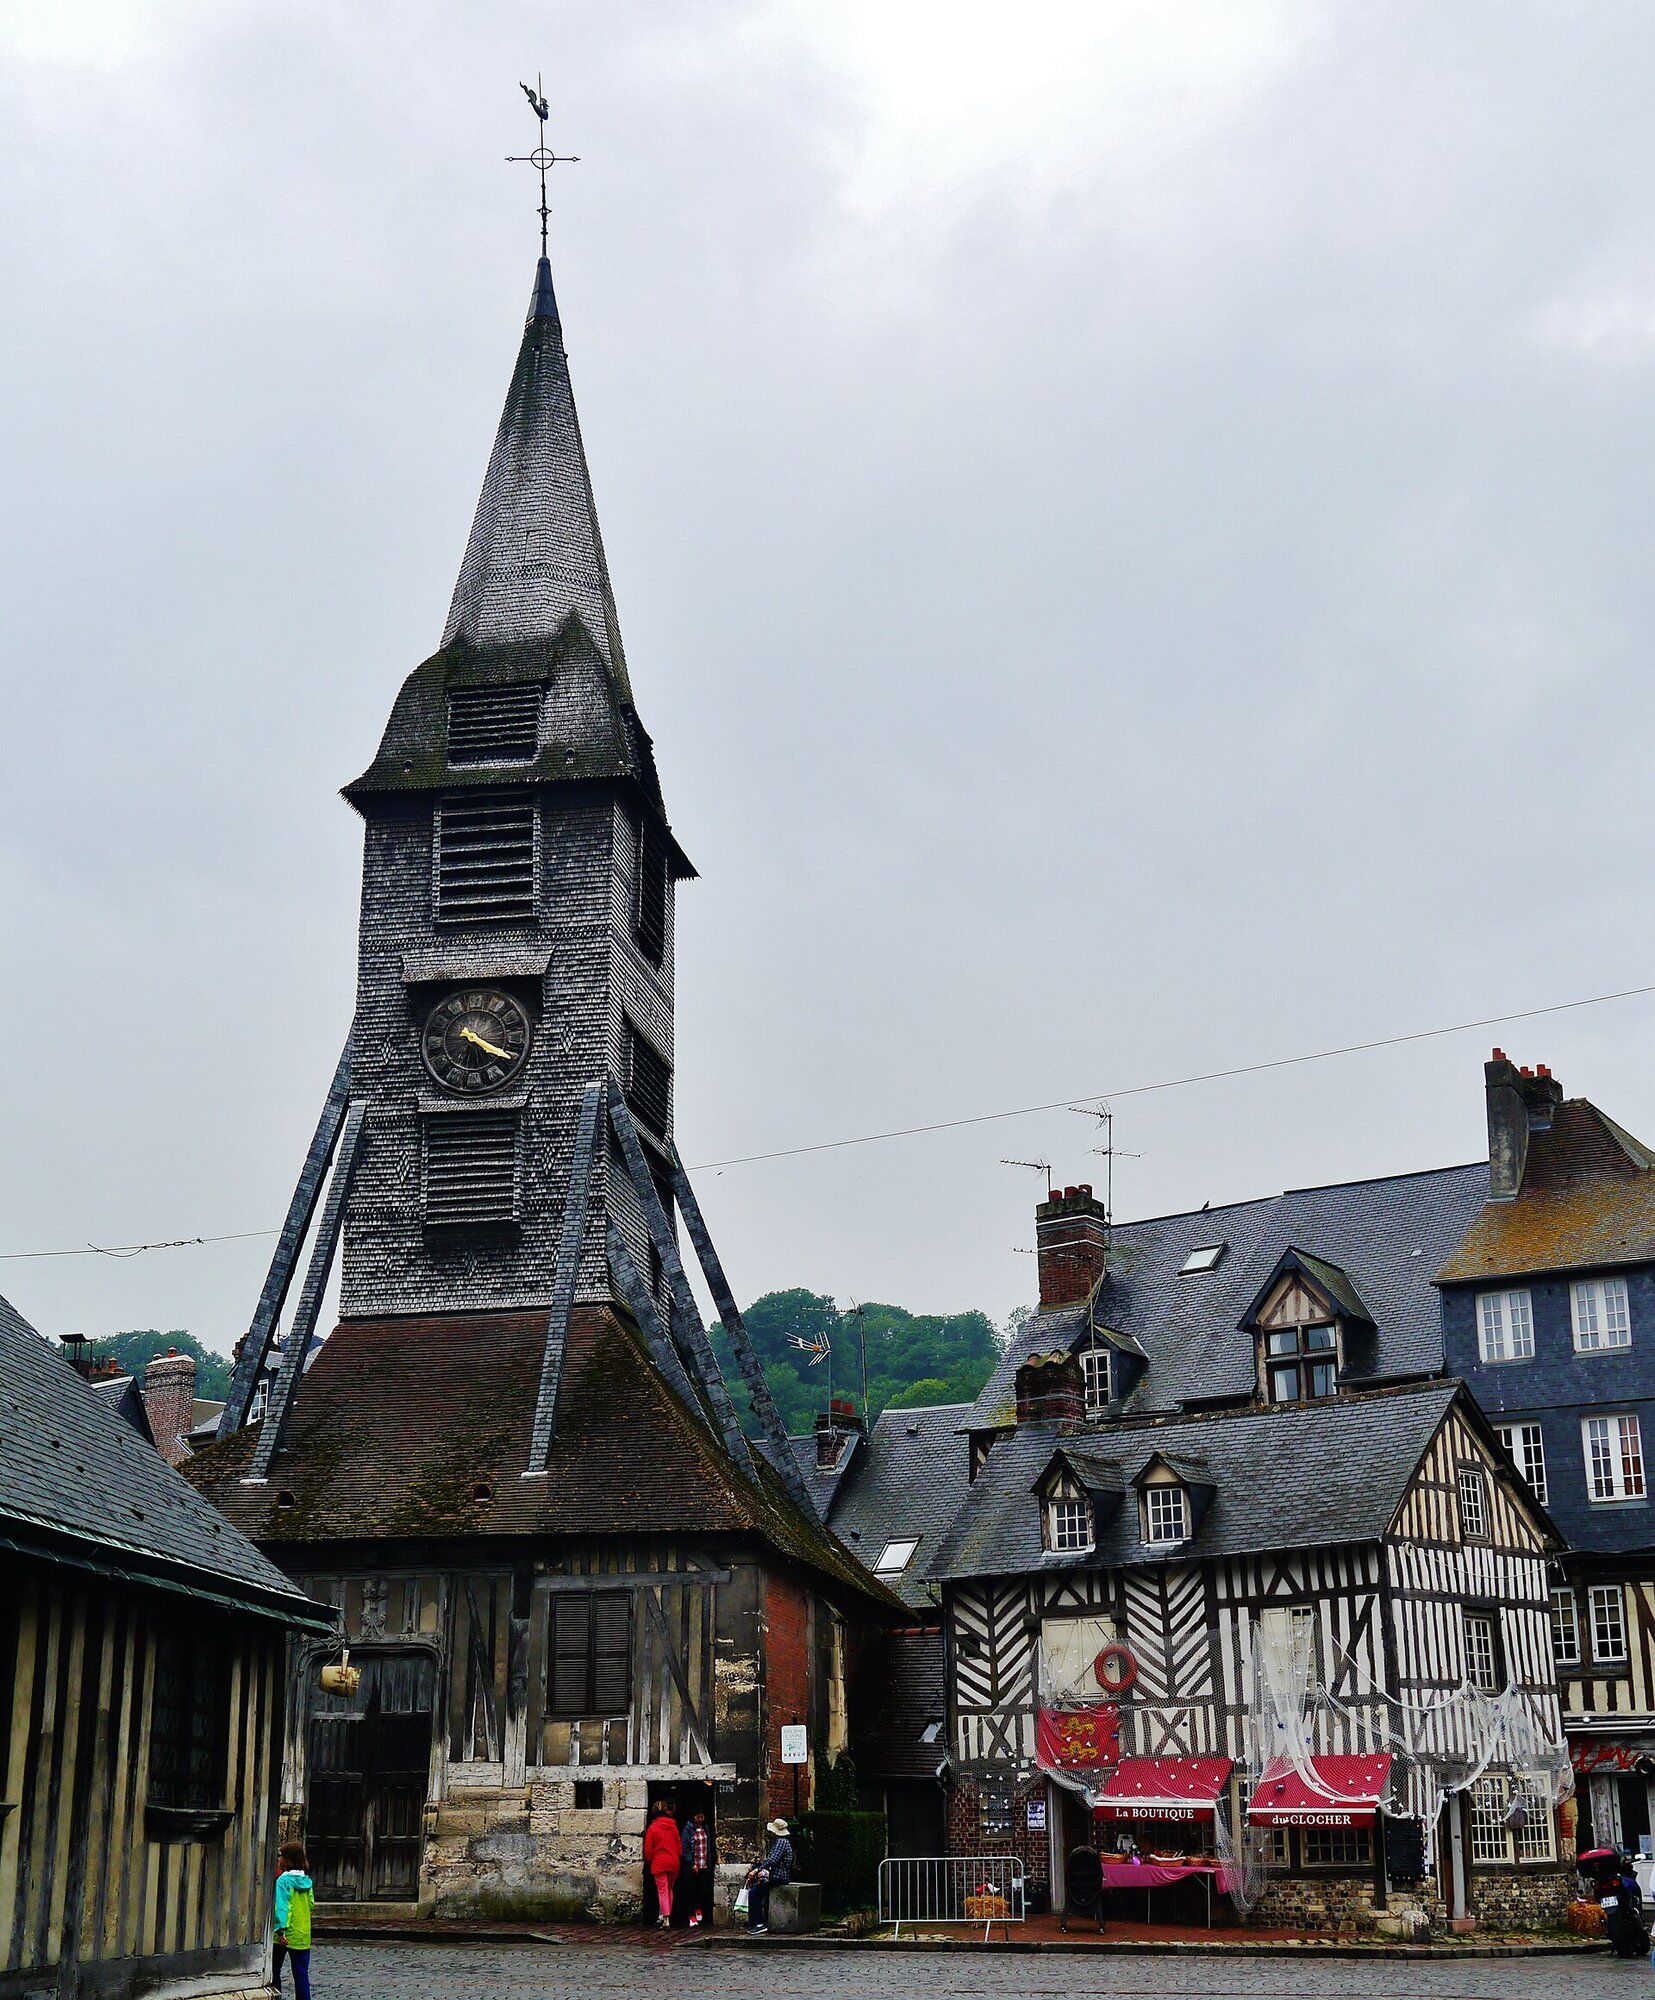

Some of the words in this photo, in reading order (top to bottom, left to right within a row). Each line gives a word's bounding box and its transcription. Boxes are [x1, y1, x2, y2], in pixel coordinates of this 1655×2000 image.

[1116, 1808, 1128, 1817] La
[1132, 1808, 1194, 1821] BOUTIQUE
[1272, 1815, 1287, 1824] du
[1290, 1815, 1352, 1825] CLOCHER
